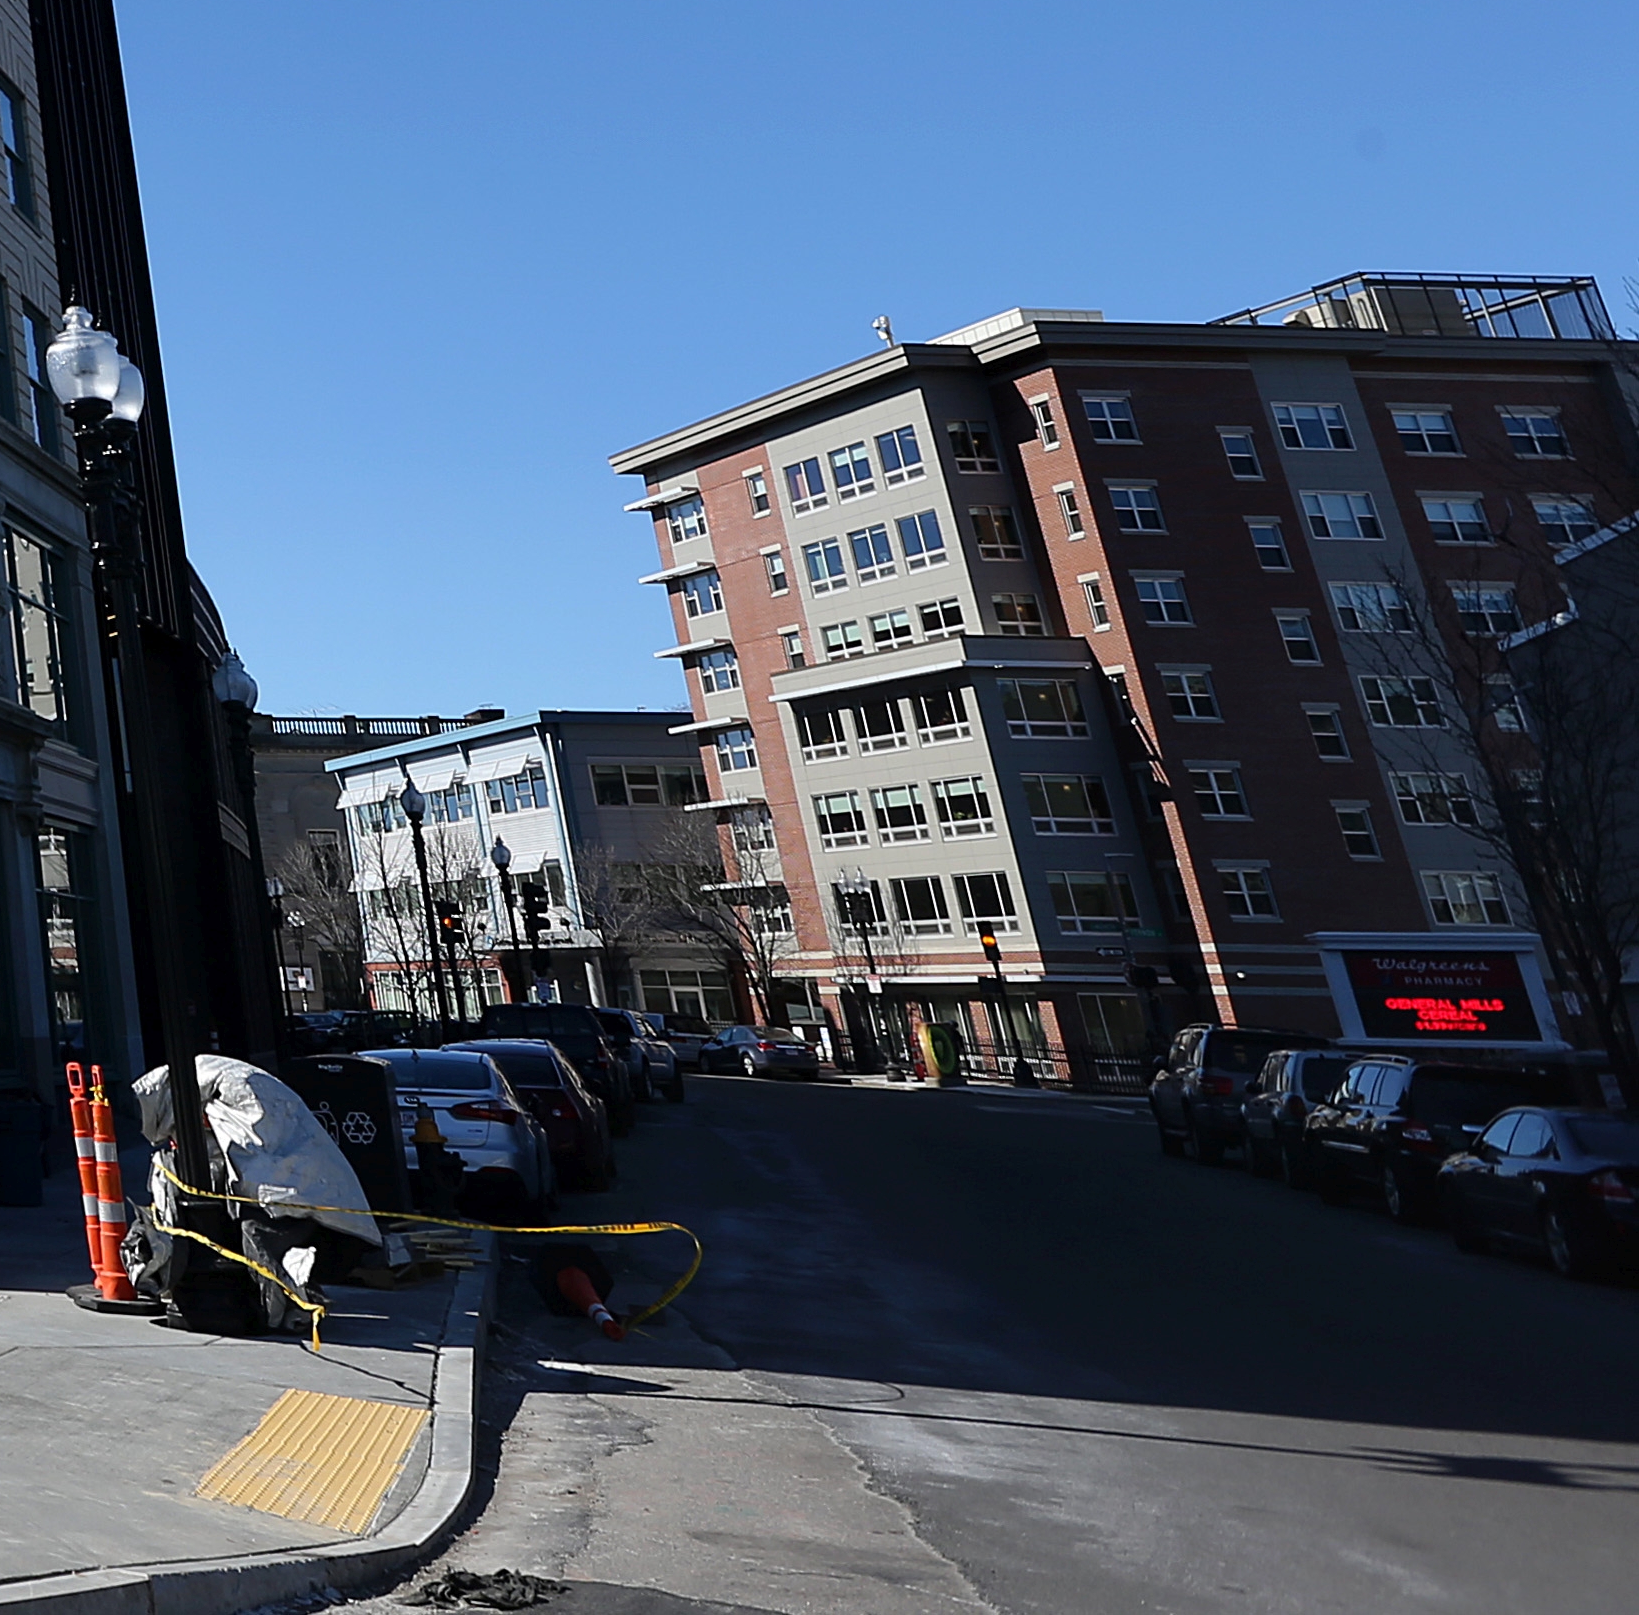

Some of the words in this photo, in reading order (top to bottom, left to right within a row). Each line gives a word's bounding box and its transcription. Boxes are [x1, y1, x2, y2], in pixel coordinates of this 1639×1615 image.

[1373, 957, 1490, 973] Walgreens
[1404, 976, 1482, 985] PHARMACY
[1385, 998, 1457, 1010] GENERAL
[1459, 999, 1505, 1011] MILLS
[1417, 1010, 1478, 1020] CEREAL
